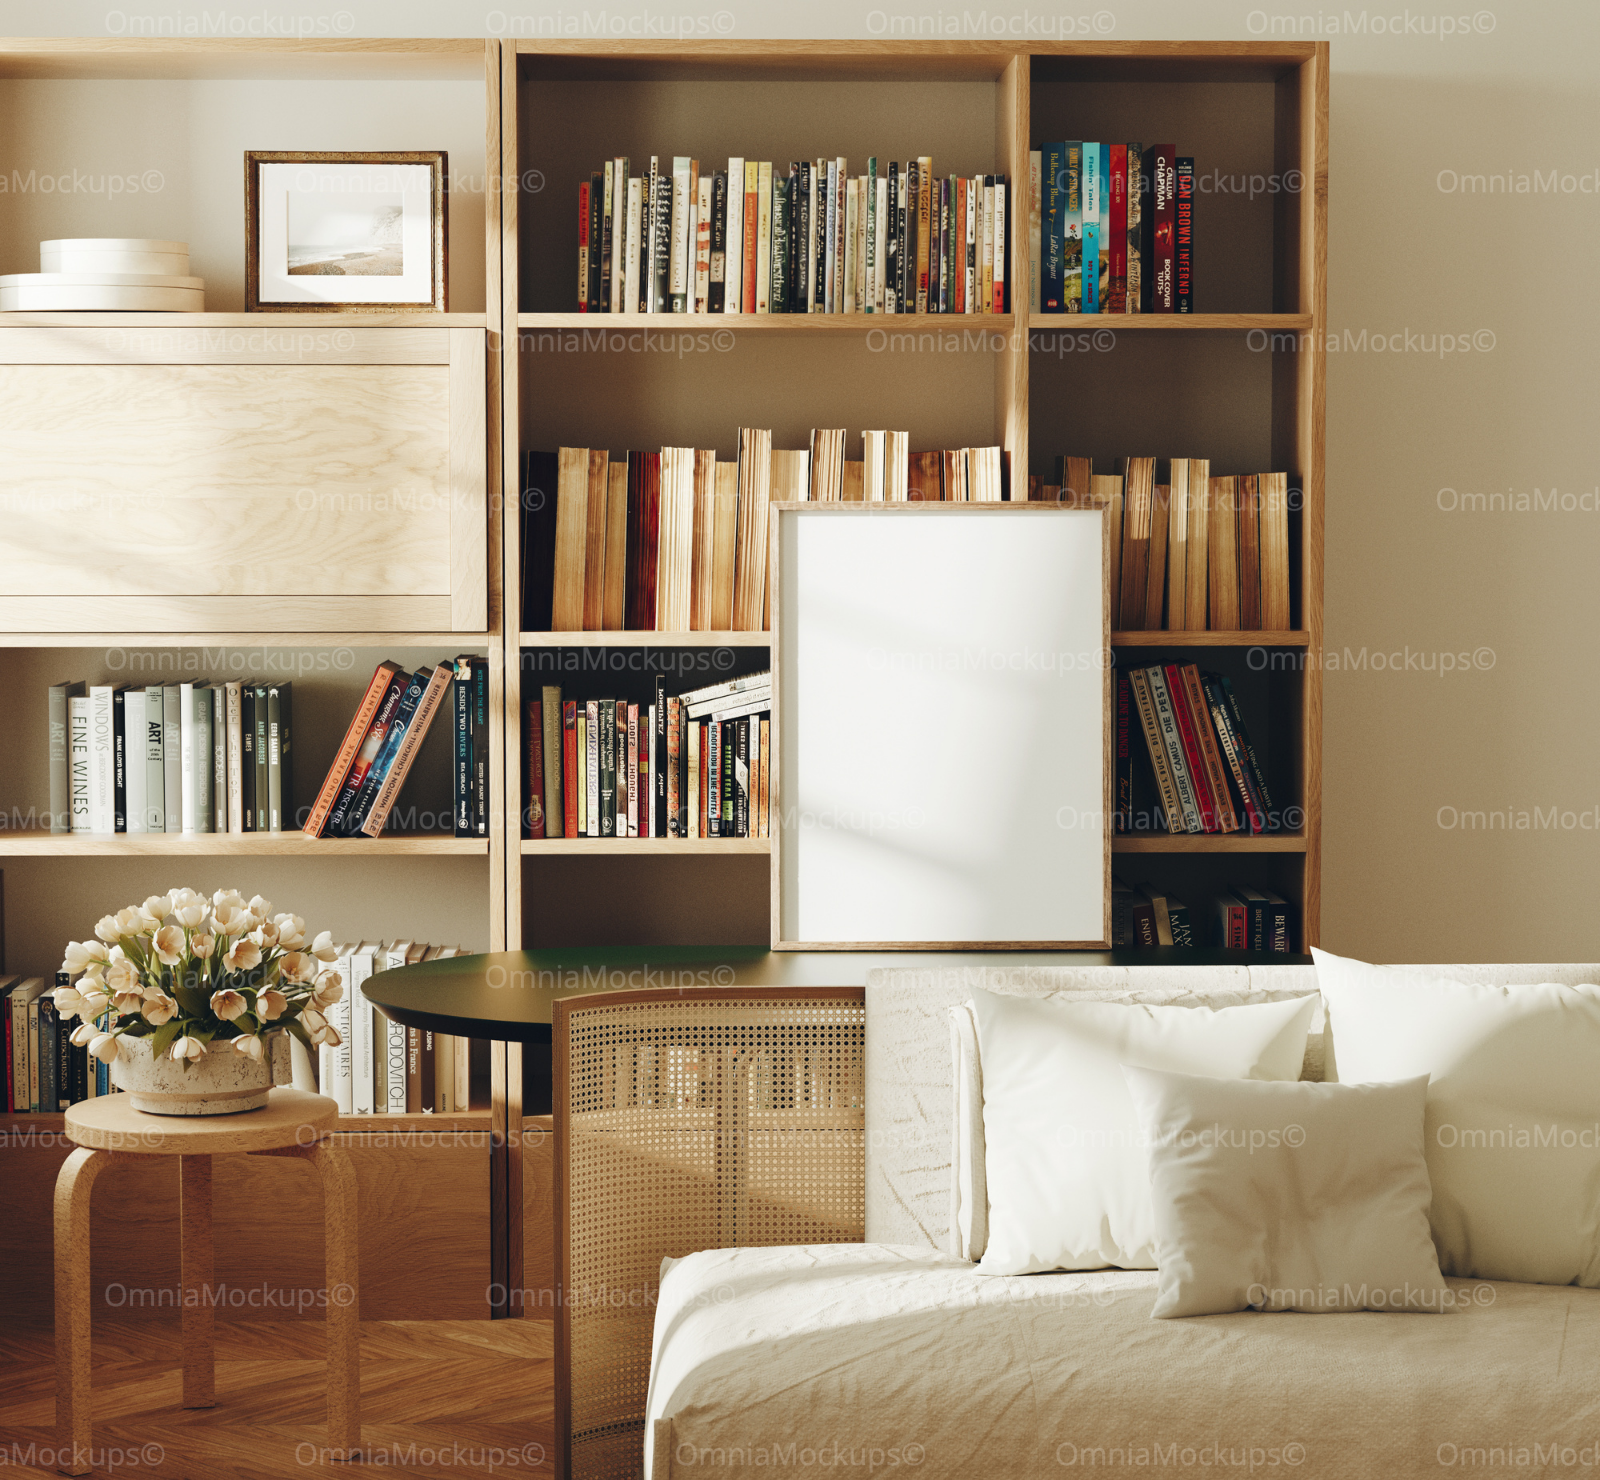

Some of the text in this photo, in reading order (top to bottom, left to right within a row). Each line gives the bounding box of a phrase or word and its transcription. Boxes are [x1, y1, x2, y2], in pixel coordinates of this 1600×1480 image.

[1069, 148, 1079, 169] FAMILY
[1047, 153, 1059, 207] Buttercup Blues
[1069, 178, 1079, 212] STRANGERS
[1157, 156, 1165, 210] CHAPMAN
[1178, 176, 1191, 199] DAN
[1178, 203, 1191, 244] BROWN
[1046, 256, 1058, 280] Bryant
[1179, 249, 1190, 294] INFERNO
[381, 685, 402, 725] Changing
[1138, 685, 1149, 707] FRAU
[1191, 683, 1201, 703] STAUB
[51, 721, 65, 745] ART
[72, 716, 88, 753] FINE
[94, 691, 109, 752] WINDOWS
[148, 721, 162, 745] ART
[166, 721, 179, 745] ART
[1119, 679, 1129, 758] DEADLINE TO DANGER
[198, 701, 208, 806] GRAPHIC DESIGN REFERENCED
[215, 745, 224, 784] BORDEAUX
[320, 684, 382, 810] BRUNO FRANK CERVANTES
[379, 683, 441, 808] WINSTON CHURCHILL WELTABENTEUER
[1155, 685, 1192, 805] ALBERT CAMUS DIE PEST
[1157, 754, 1166, 775] BUCK
[1219, 728, 1250, 804] EVERYTHING BROKEN
[1249, 750, 1259, 770] WING
[1254, 769, 1262, 782] AND
[1263, 786, 1273, 808] PRAYER
[73, 761, 89, 815] WINES
[332, 772, 362, 824] TR FISCHER
[1120, 777, 1129, 800] Brad
[1140, 918, 1153, 946] ENJOY
[1275, 915, 1285, 953] BEWARE
[341, 998, 351, 1078] ANTIQUAIRES
[362, 1023, 370, 1079] Residential Architecture
[410, 1048, 419, 1075] France
